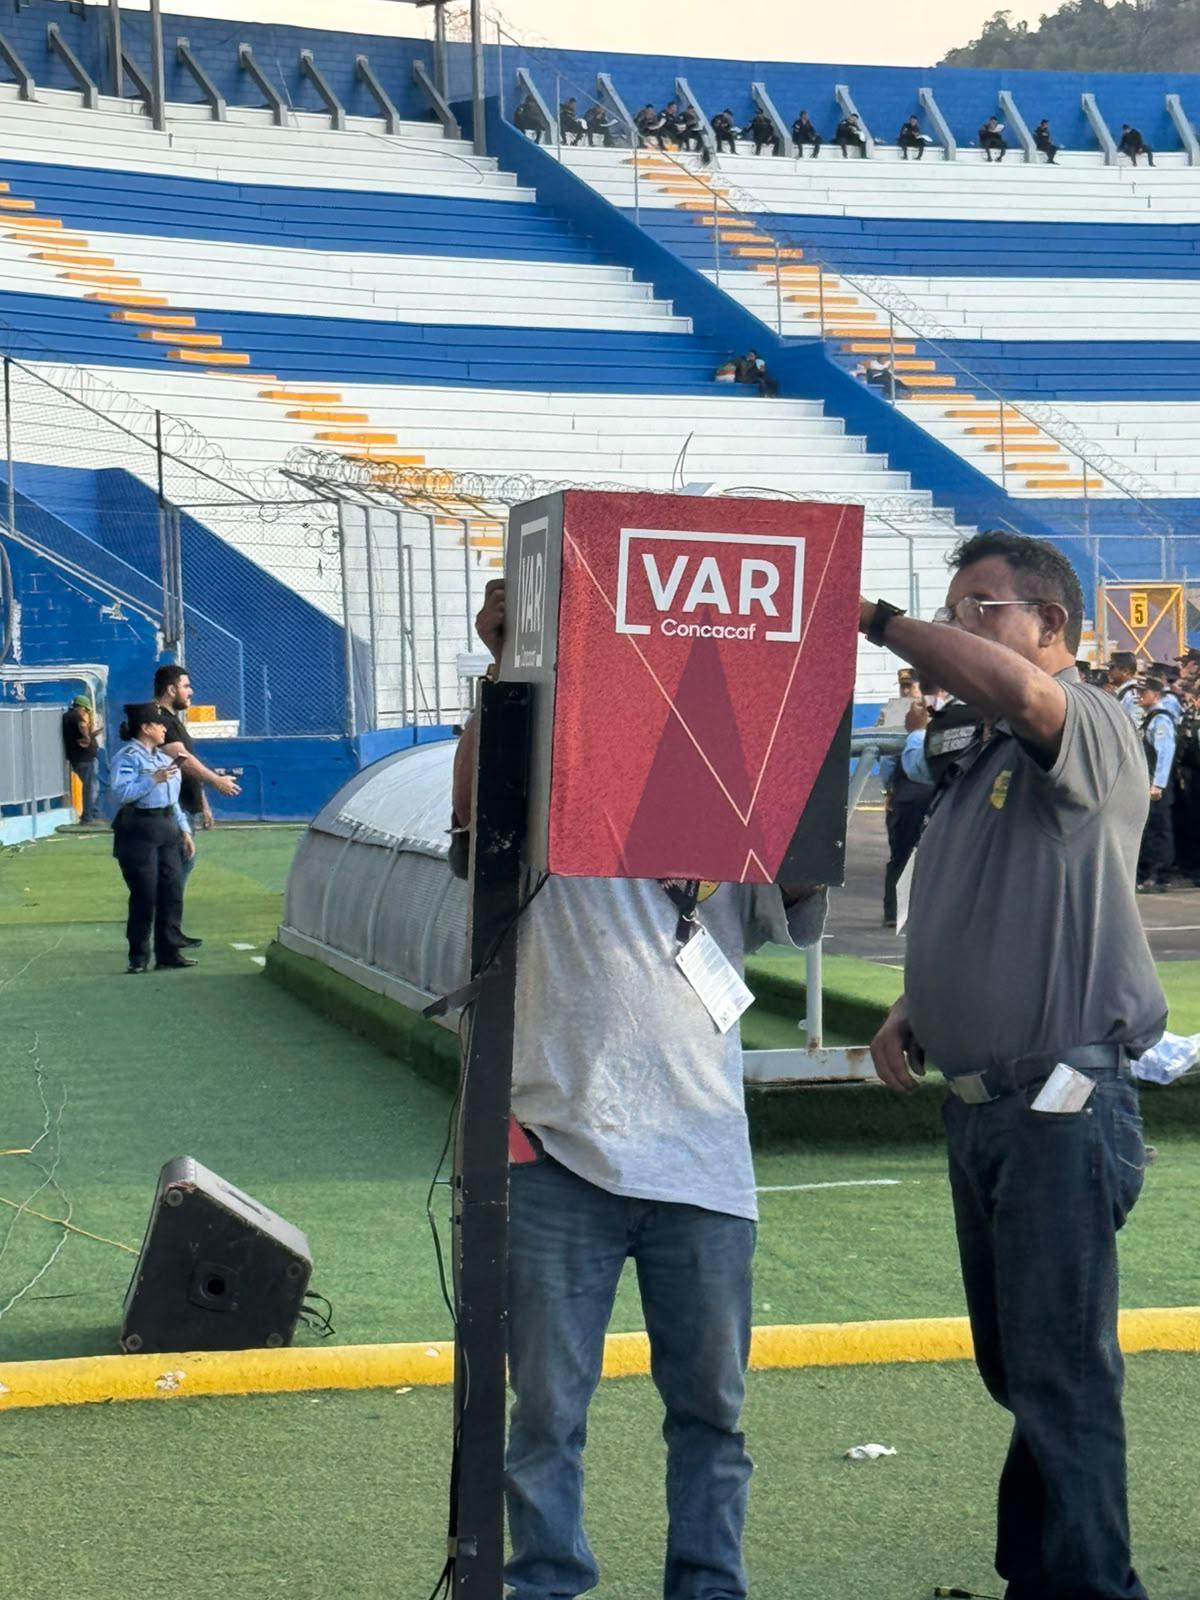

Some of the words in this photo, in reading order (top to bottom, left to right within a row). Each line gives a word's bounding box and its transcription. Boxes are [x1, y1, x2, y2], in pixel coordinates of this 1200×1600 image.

[521, 552, 543, 632] VAR
[641, 554, 779, 616] VAR
[661, 618, 756, 640] Concacaf
[1135, 603, 1143, 624] 5
